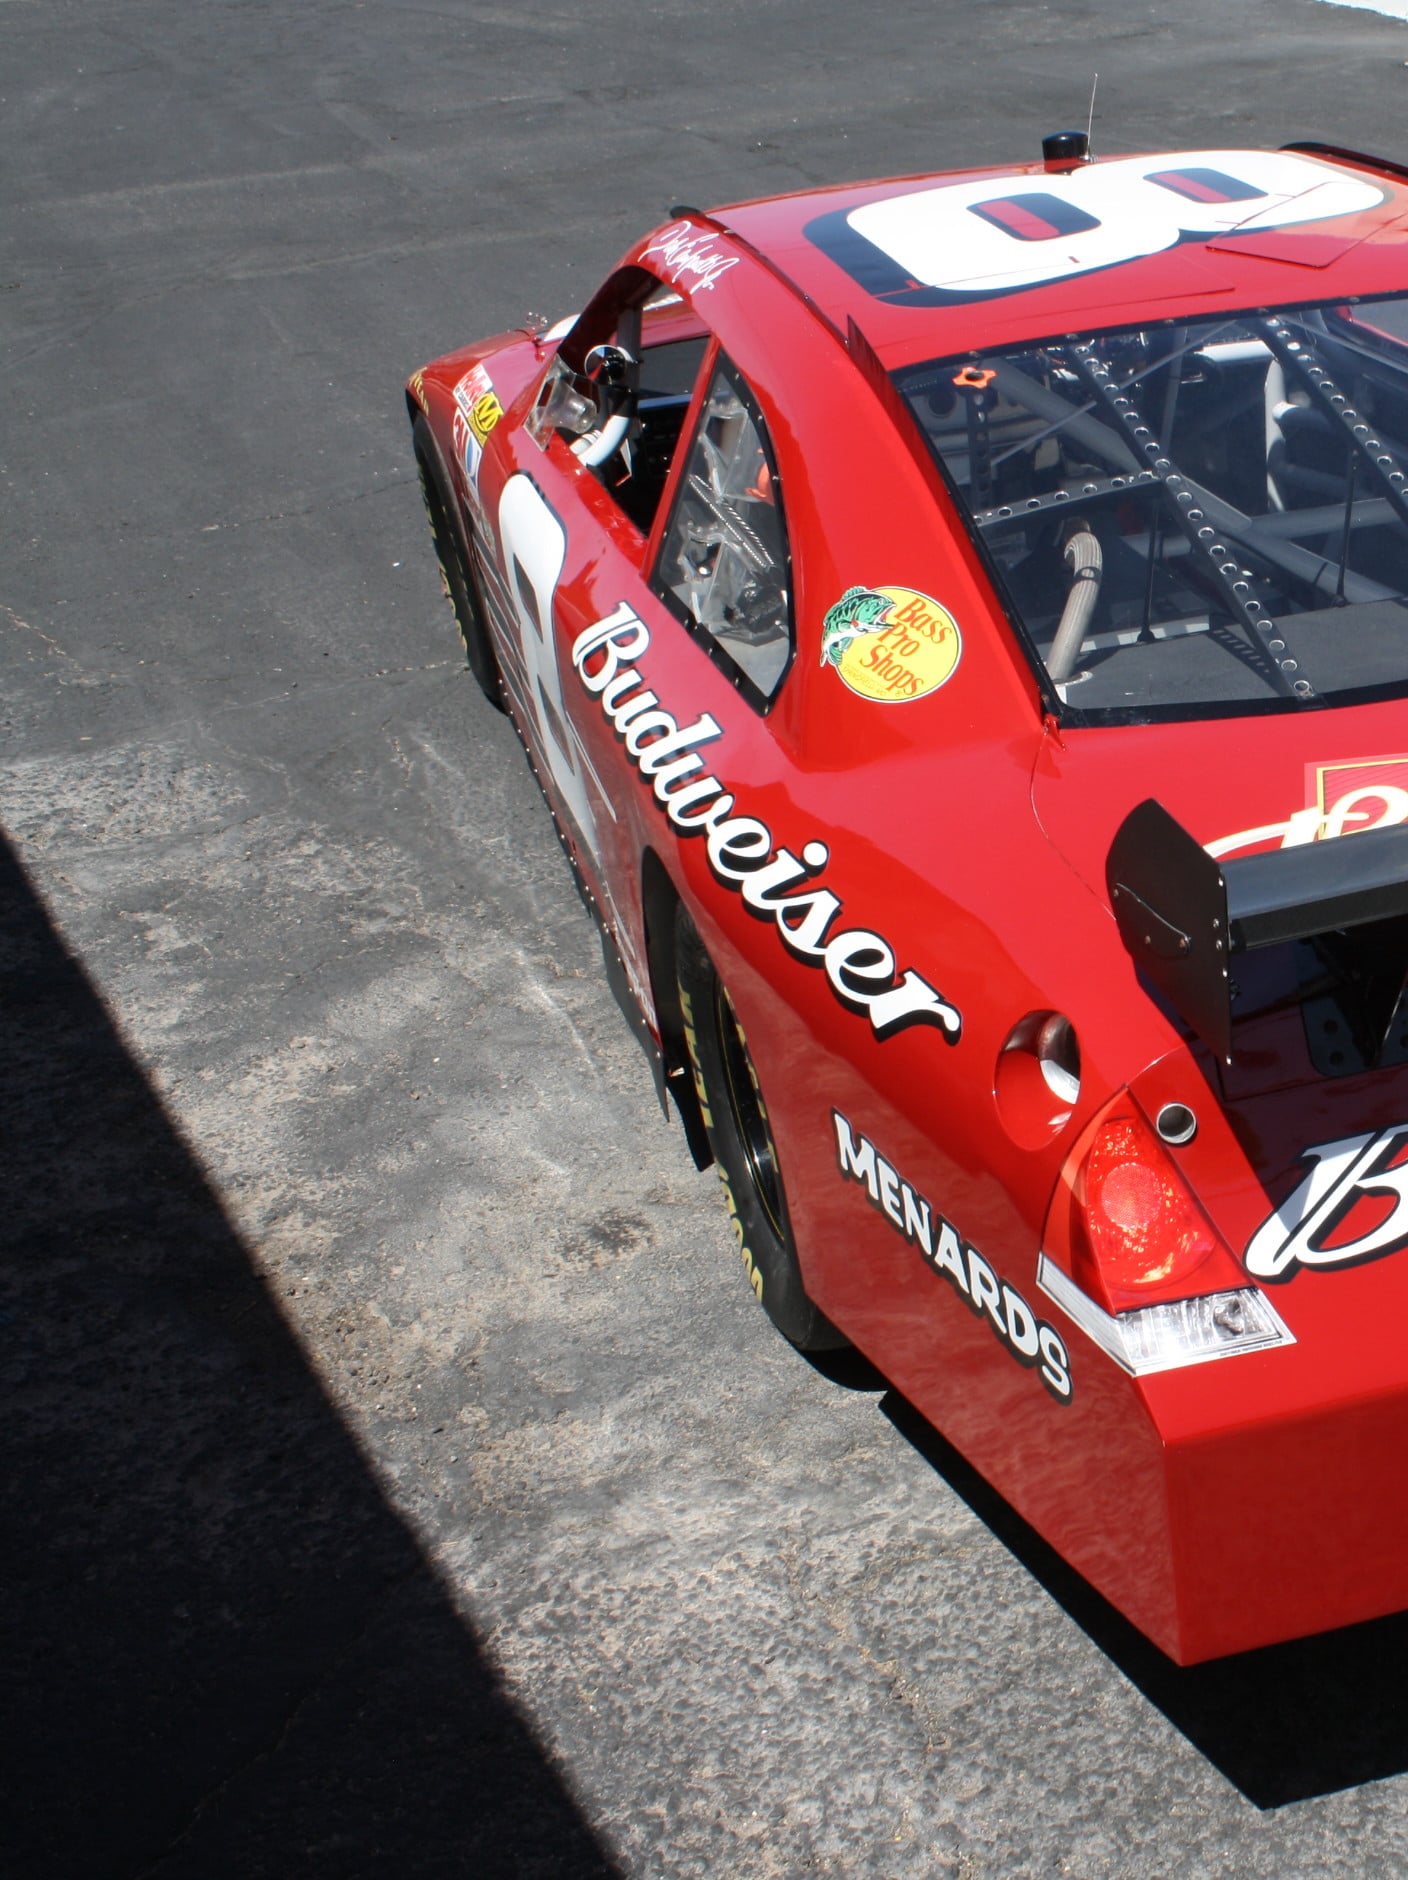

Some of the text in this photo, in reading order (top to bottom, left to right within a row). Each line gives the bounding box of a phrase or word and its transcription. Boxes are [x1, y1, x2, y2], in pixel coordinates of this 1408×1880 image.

[802, 149, 1388, 308] 8
[859, 644, 924, 696] Shops
[877, 621, 920, 657] Pro
[894, 597, 952, 645] Bass
[571, 600, 962, 1046] Budweiser
[831, 1106, 1075, 1406] MENARDS
